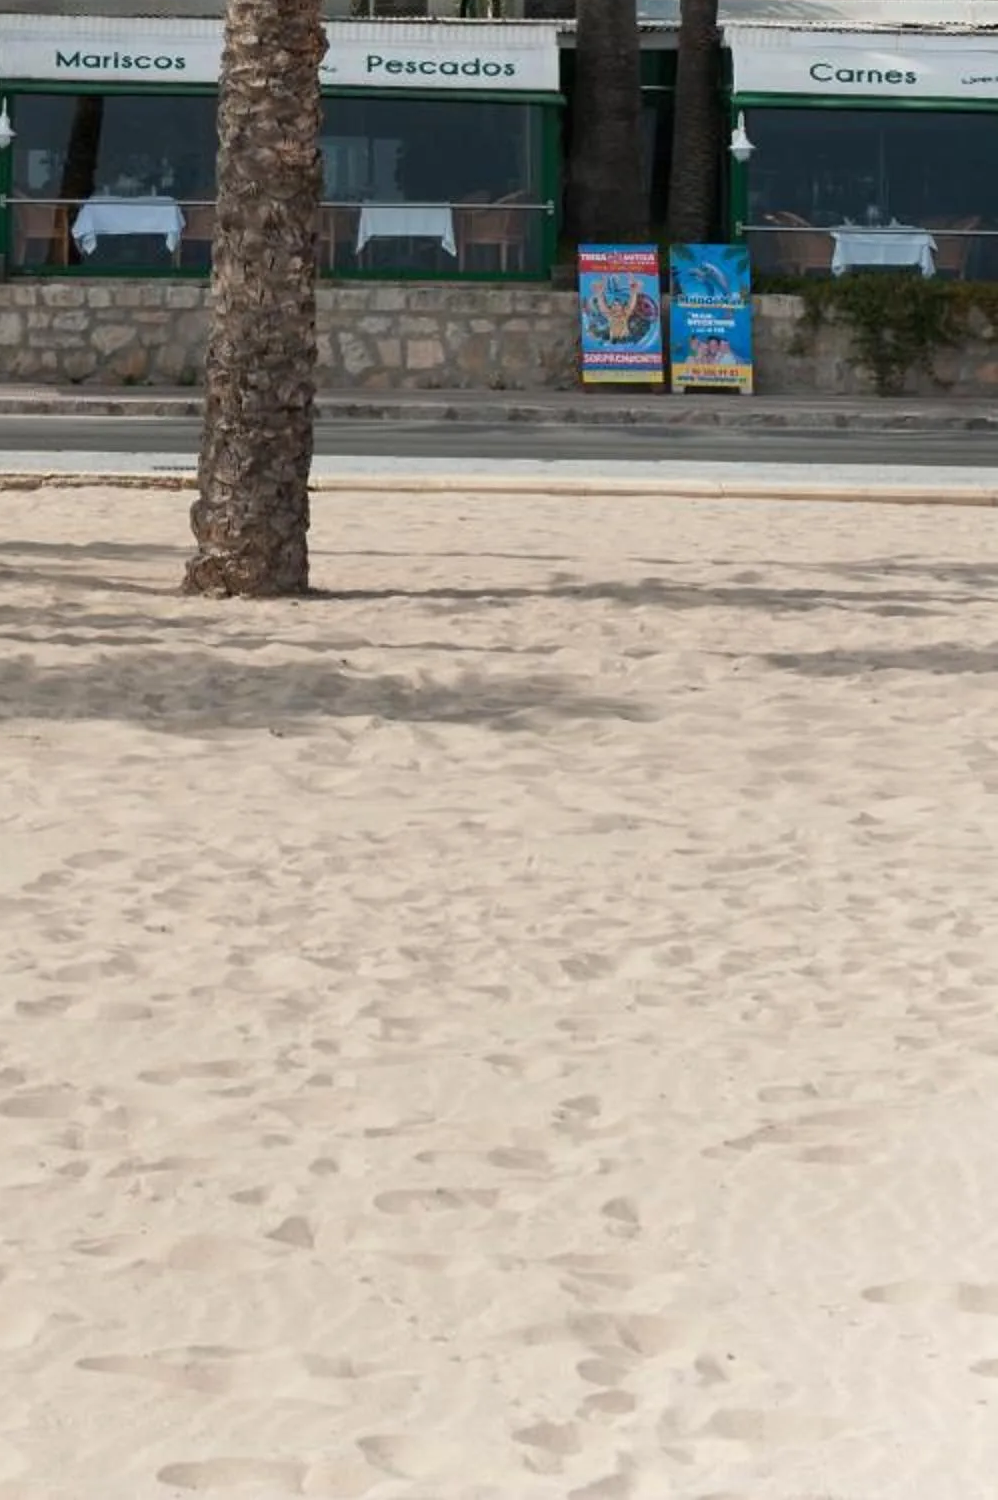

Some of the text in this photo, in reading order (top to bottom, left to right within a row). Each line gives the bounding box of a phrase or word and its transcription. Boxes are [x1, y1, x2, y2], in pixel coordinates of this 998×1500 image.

[55, 51, 186, 69] Mariscos
[366, 54, 515, 77] Pescados
[809, 63, 917, 85] Carnes
